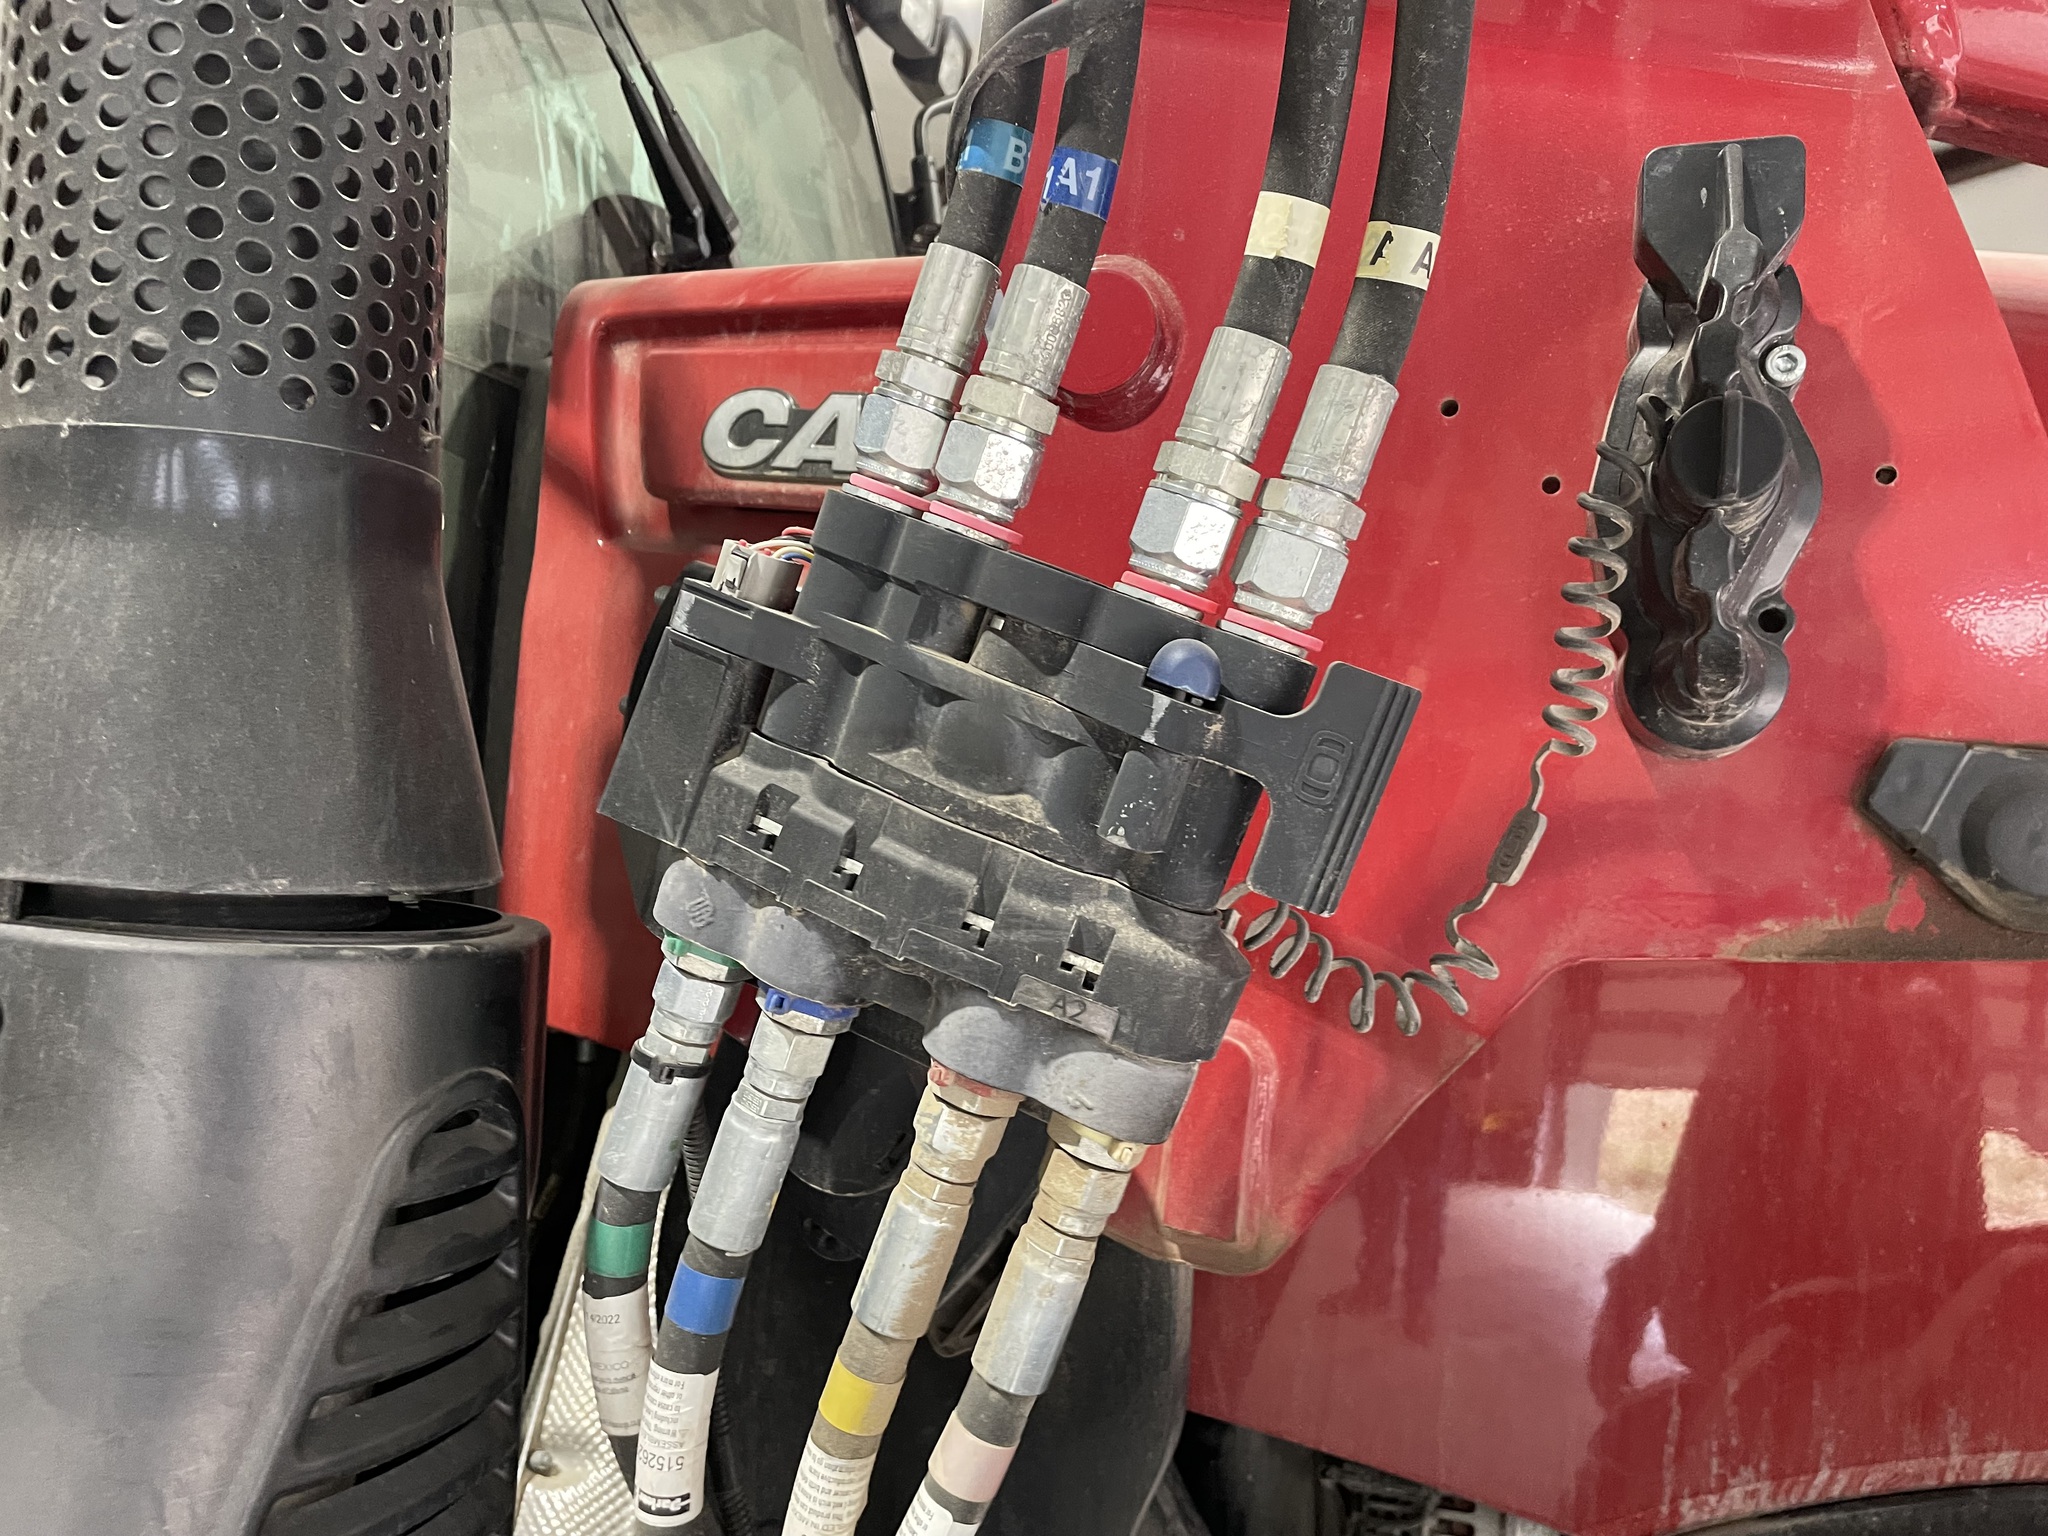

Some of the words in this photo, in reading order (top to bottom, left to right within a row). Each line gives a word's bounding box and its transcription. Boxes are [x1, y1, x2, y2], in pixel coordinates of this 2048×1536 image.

[1057, 156, 1103, 202] A1
[702, 387, 862, 473] CA
[1048, 994, 1088, 1025] A2
